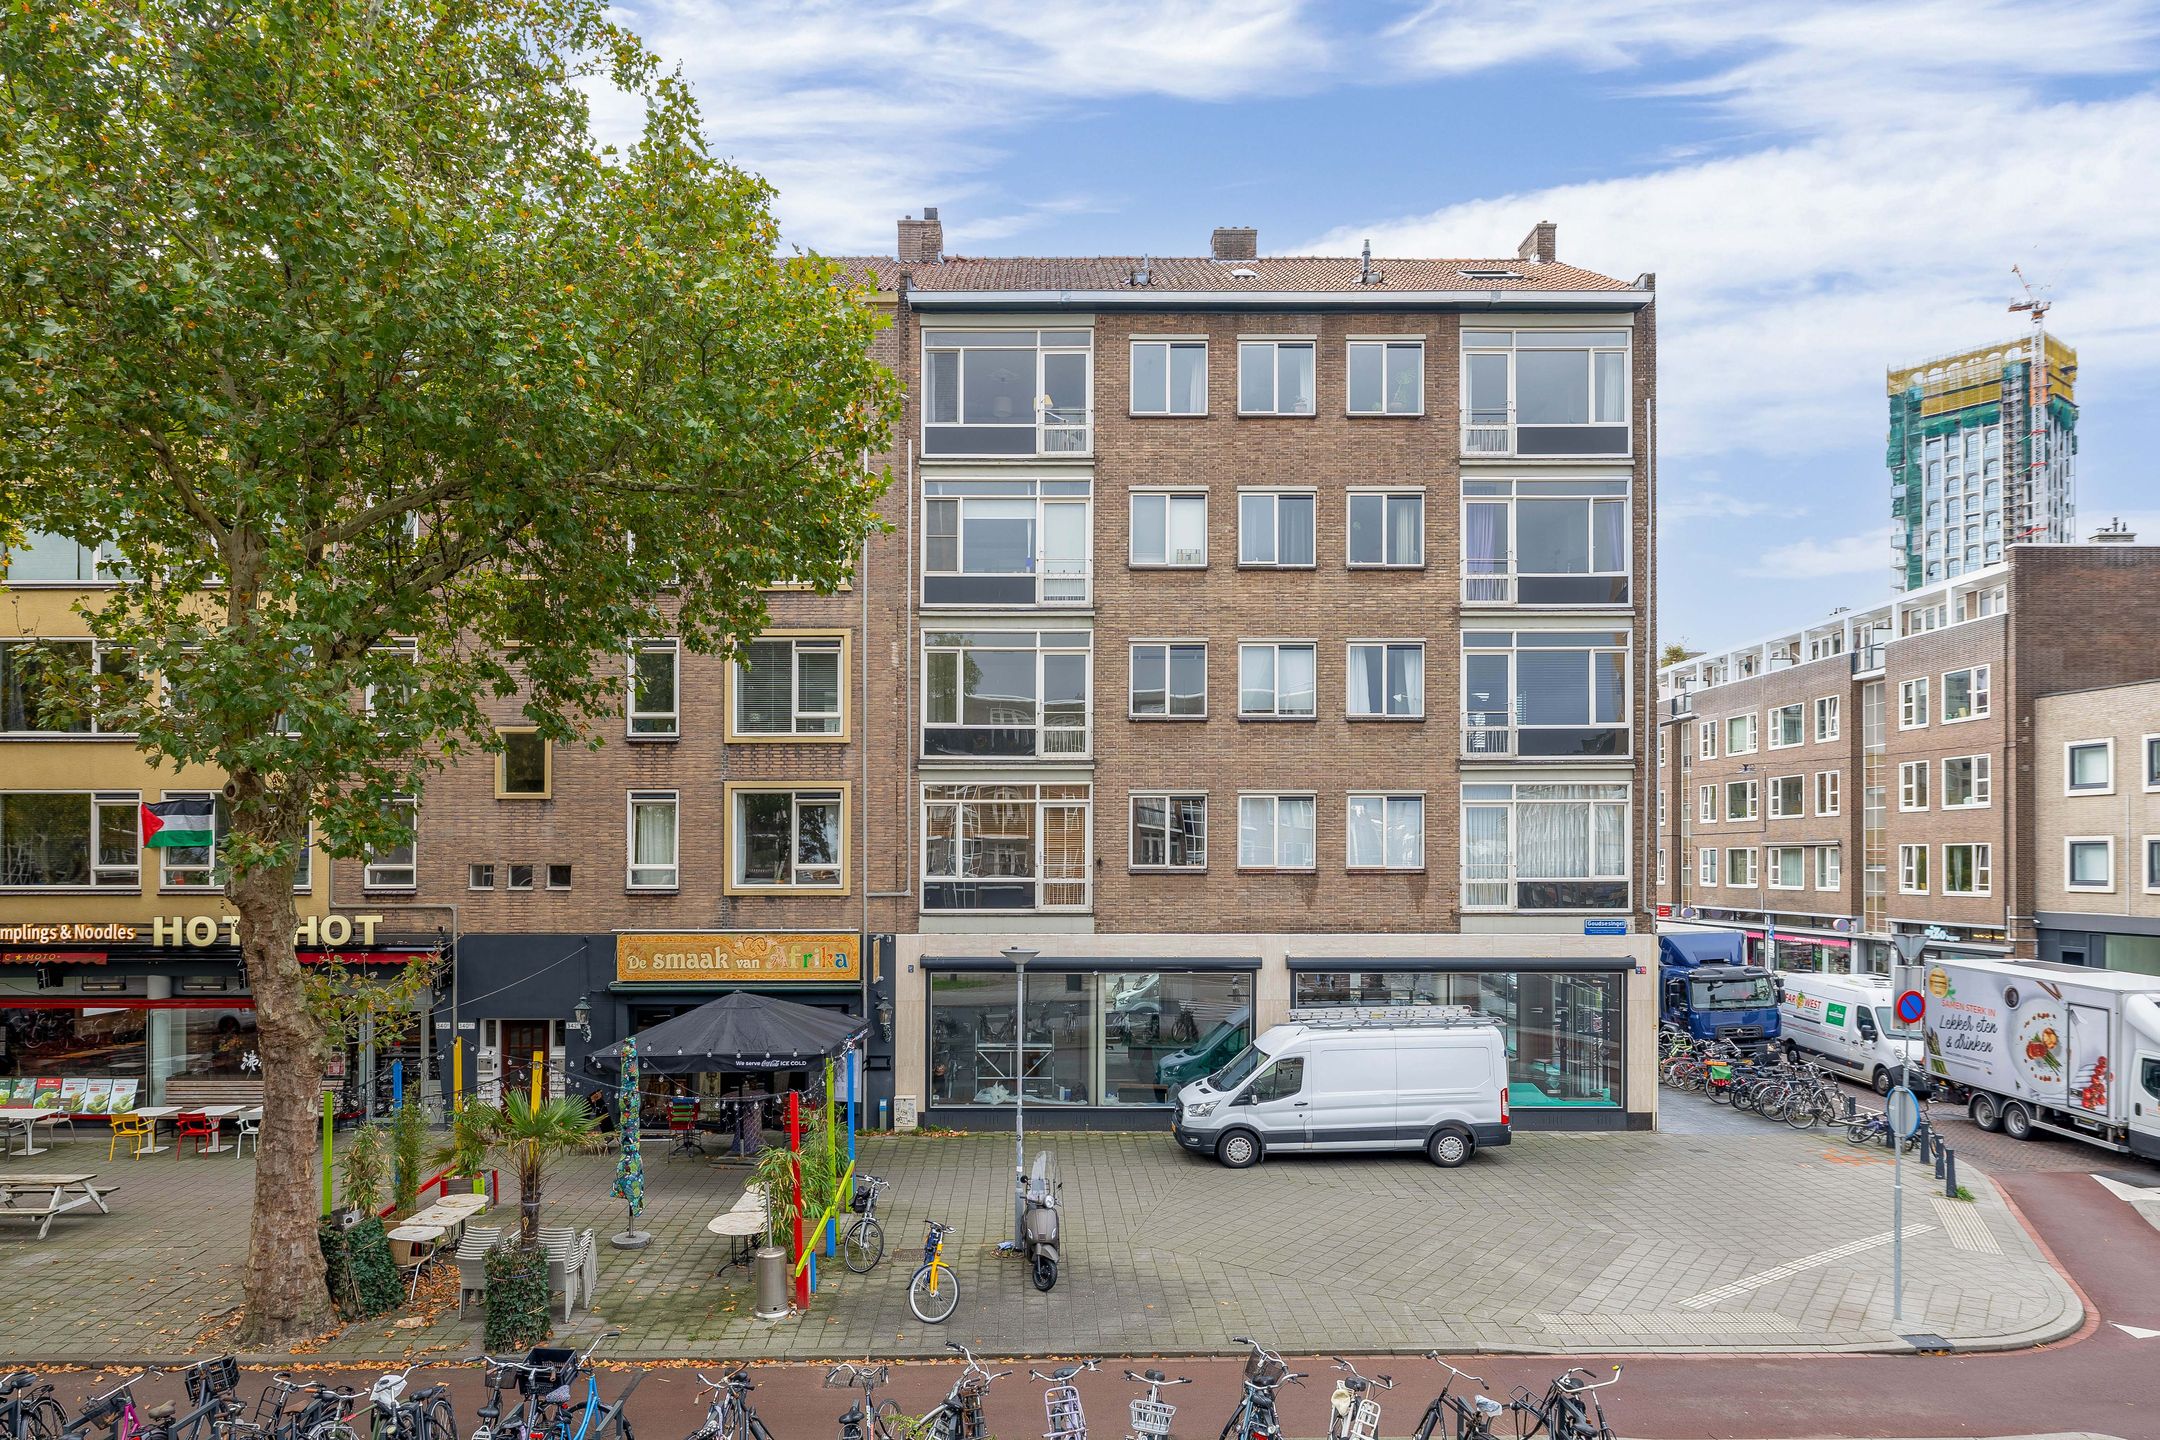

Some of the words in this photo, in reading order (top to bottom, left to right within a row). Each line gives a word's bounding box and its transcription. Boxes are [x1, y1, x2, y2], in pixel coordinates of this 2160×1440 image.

[60, 924, 72, 940] &
[74, 923, 136, 940] Noodles
[293, 915, 384, 946] HOT
[1587, 920, 1624, 928] Goudsesingel
[26, 953, 57, 961] MOTO
[627, 956, 647, 969] De
[652, 946, 729, 969] smaak
[735, 957, 760, 969] van
[768, 945, 848, 969] Afrika
[1785, 993, 1797, 1003] FAR
[1804, 998, 1822, 1010] WEST
[1941, 1000, 1965, 1010] SAMEN
[1966, 1004, 1987, 1014] STERK
[1987, 1007, 1996, 1017] IN
[1939, 1014, 1974, 1031] Lekker
[1976, 1016, 1998, 1033] eten
[1945, 1036, 1952, 1048] &
[1954, 1033, 1994, 1053] drinken
